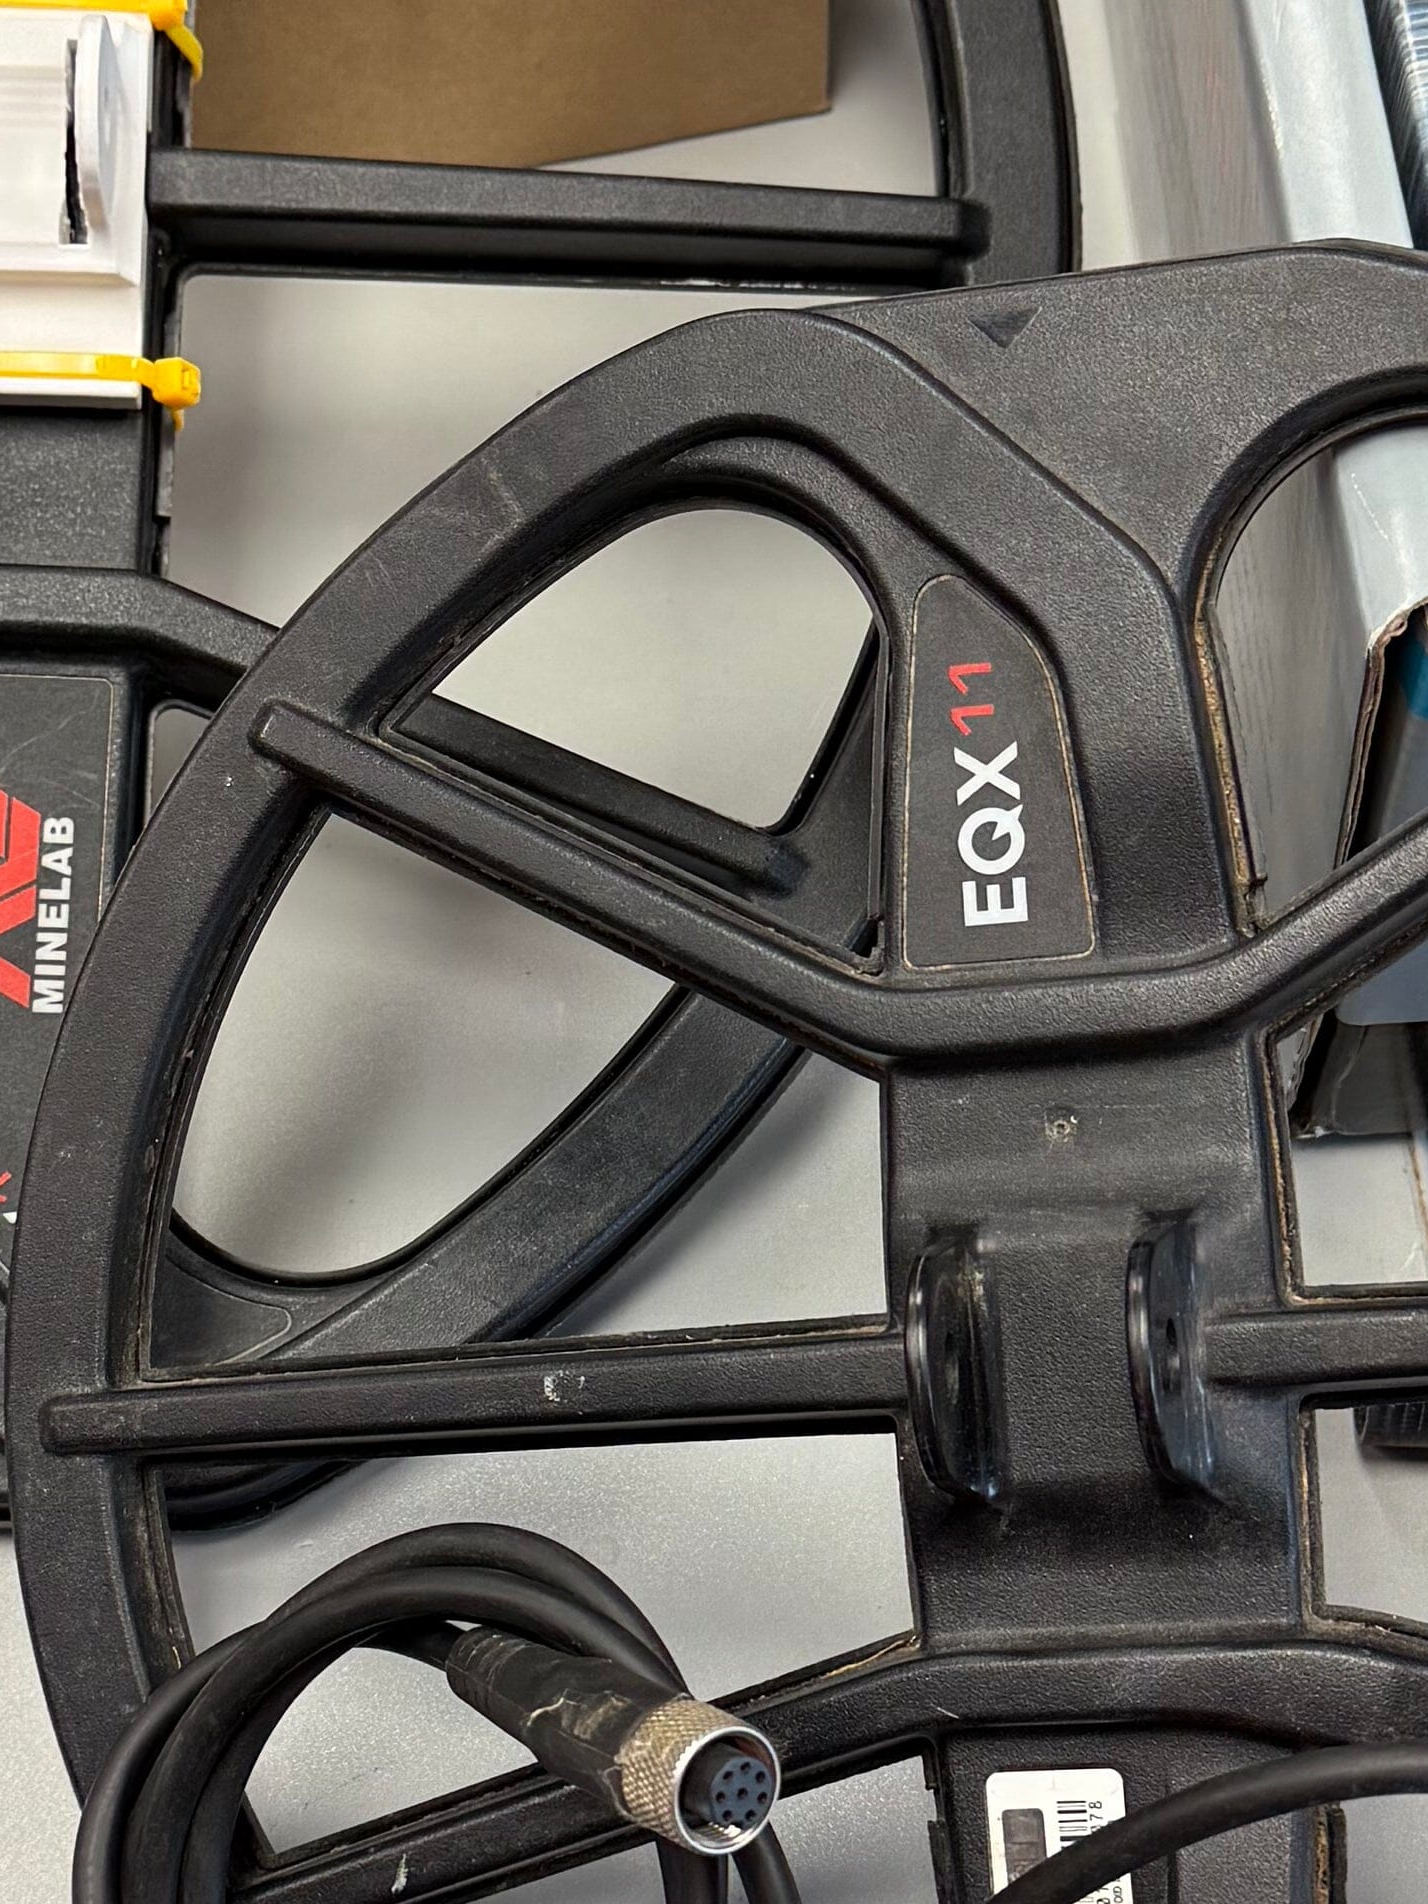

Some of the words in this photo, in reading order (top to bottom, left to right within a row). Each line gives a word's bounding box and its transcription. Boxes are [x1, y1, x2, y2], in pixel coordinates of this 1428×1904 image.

[947, 662, 995, 736] 11
[31, 815, 75, 1014] MINELAB
[954, 741, 1029, 927] EQX
